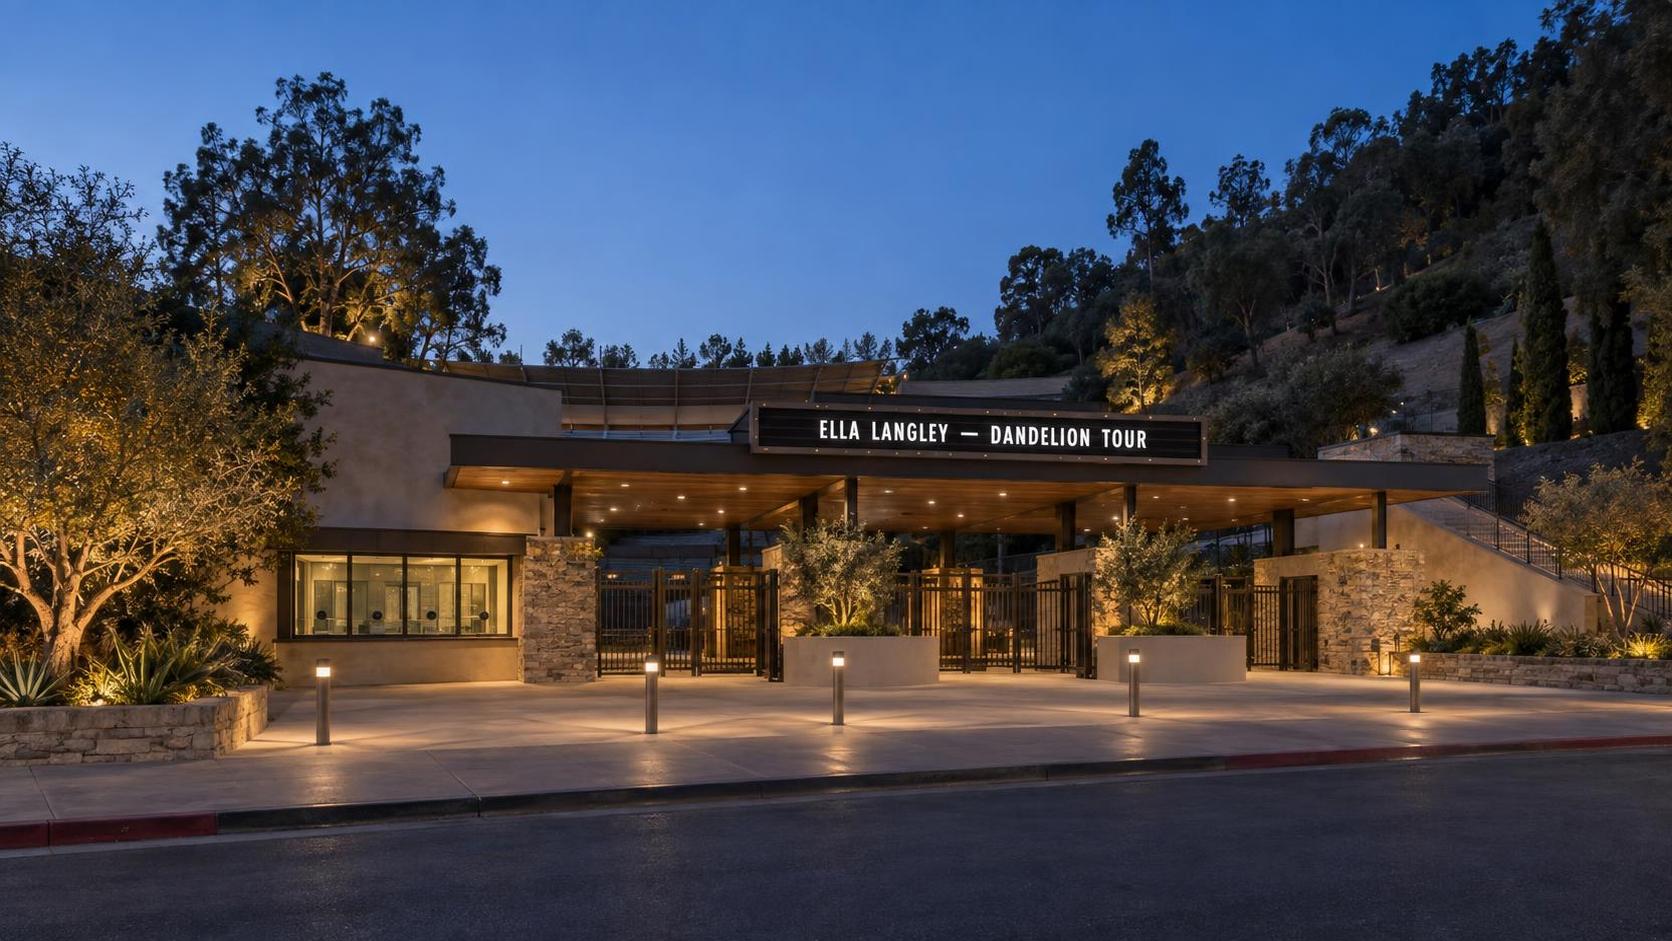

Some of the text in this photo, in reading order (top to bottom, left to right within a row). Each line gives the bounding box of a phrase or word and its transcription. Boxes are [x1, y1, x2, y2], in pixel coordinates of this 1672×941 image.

[819, 419, 860, 441] ELLA
[871, 421, 949, 443] LANGLEY
[990, 425, 1090, 447] DANDELION
[1101, 428, 1147, 449] TOUR
